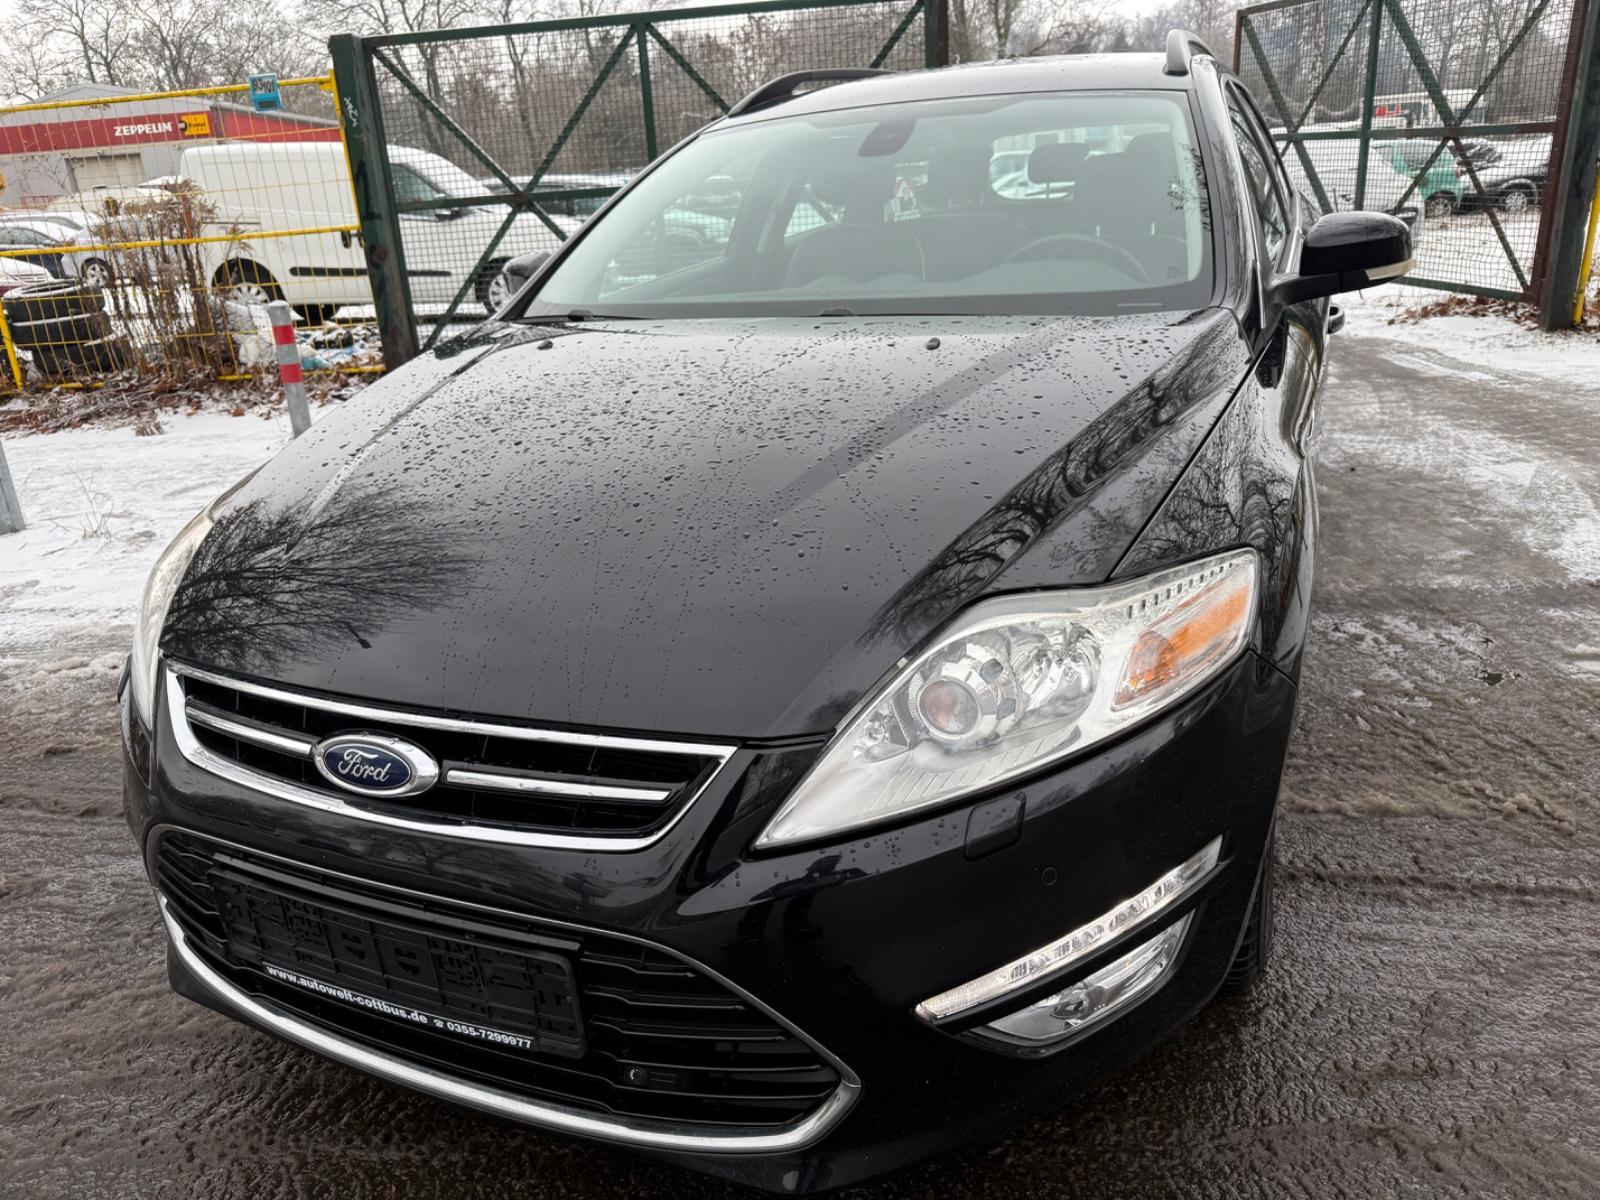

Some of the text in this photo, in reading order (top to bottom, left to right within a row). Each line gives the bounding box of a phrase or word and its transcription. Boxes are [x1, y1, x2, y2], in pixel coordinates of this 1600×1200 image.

[113, 121, 173, 137] ZEPPELIN
[337, 748, 392, 783] Ford
[266, 966, 532, 1049] www.autowelt-cottbus.de 0355-7299977
